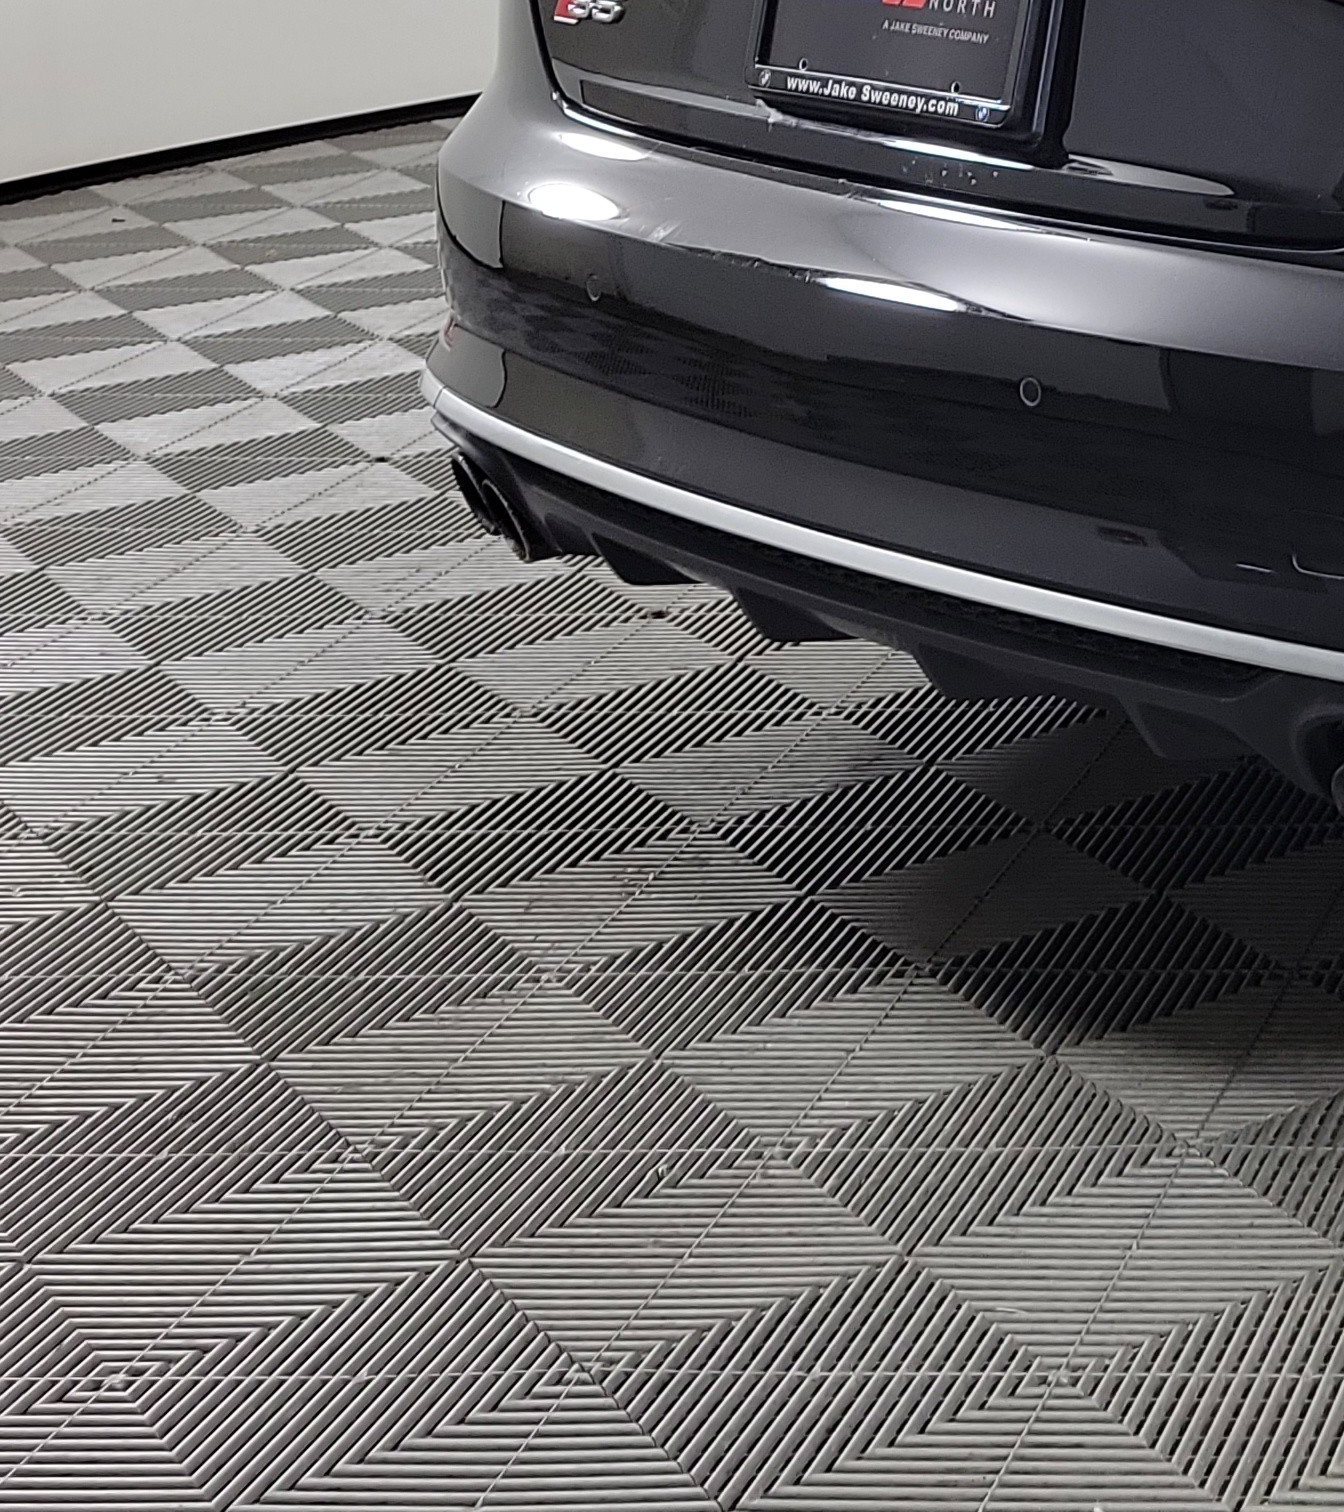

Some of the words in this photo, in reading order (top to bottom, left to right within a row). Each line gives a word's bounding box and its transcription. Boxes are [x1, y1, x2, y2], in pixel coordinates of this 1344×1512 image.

[881, 19, 889, 30] A
[890, 20, 910, 34] JAKE
[911, 23, 951, 38] SWEENEY
[949, 28, 990, 44] COMPANY
[861, 84, 959, 116] Sweeney.com
